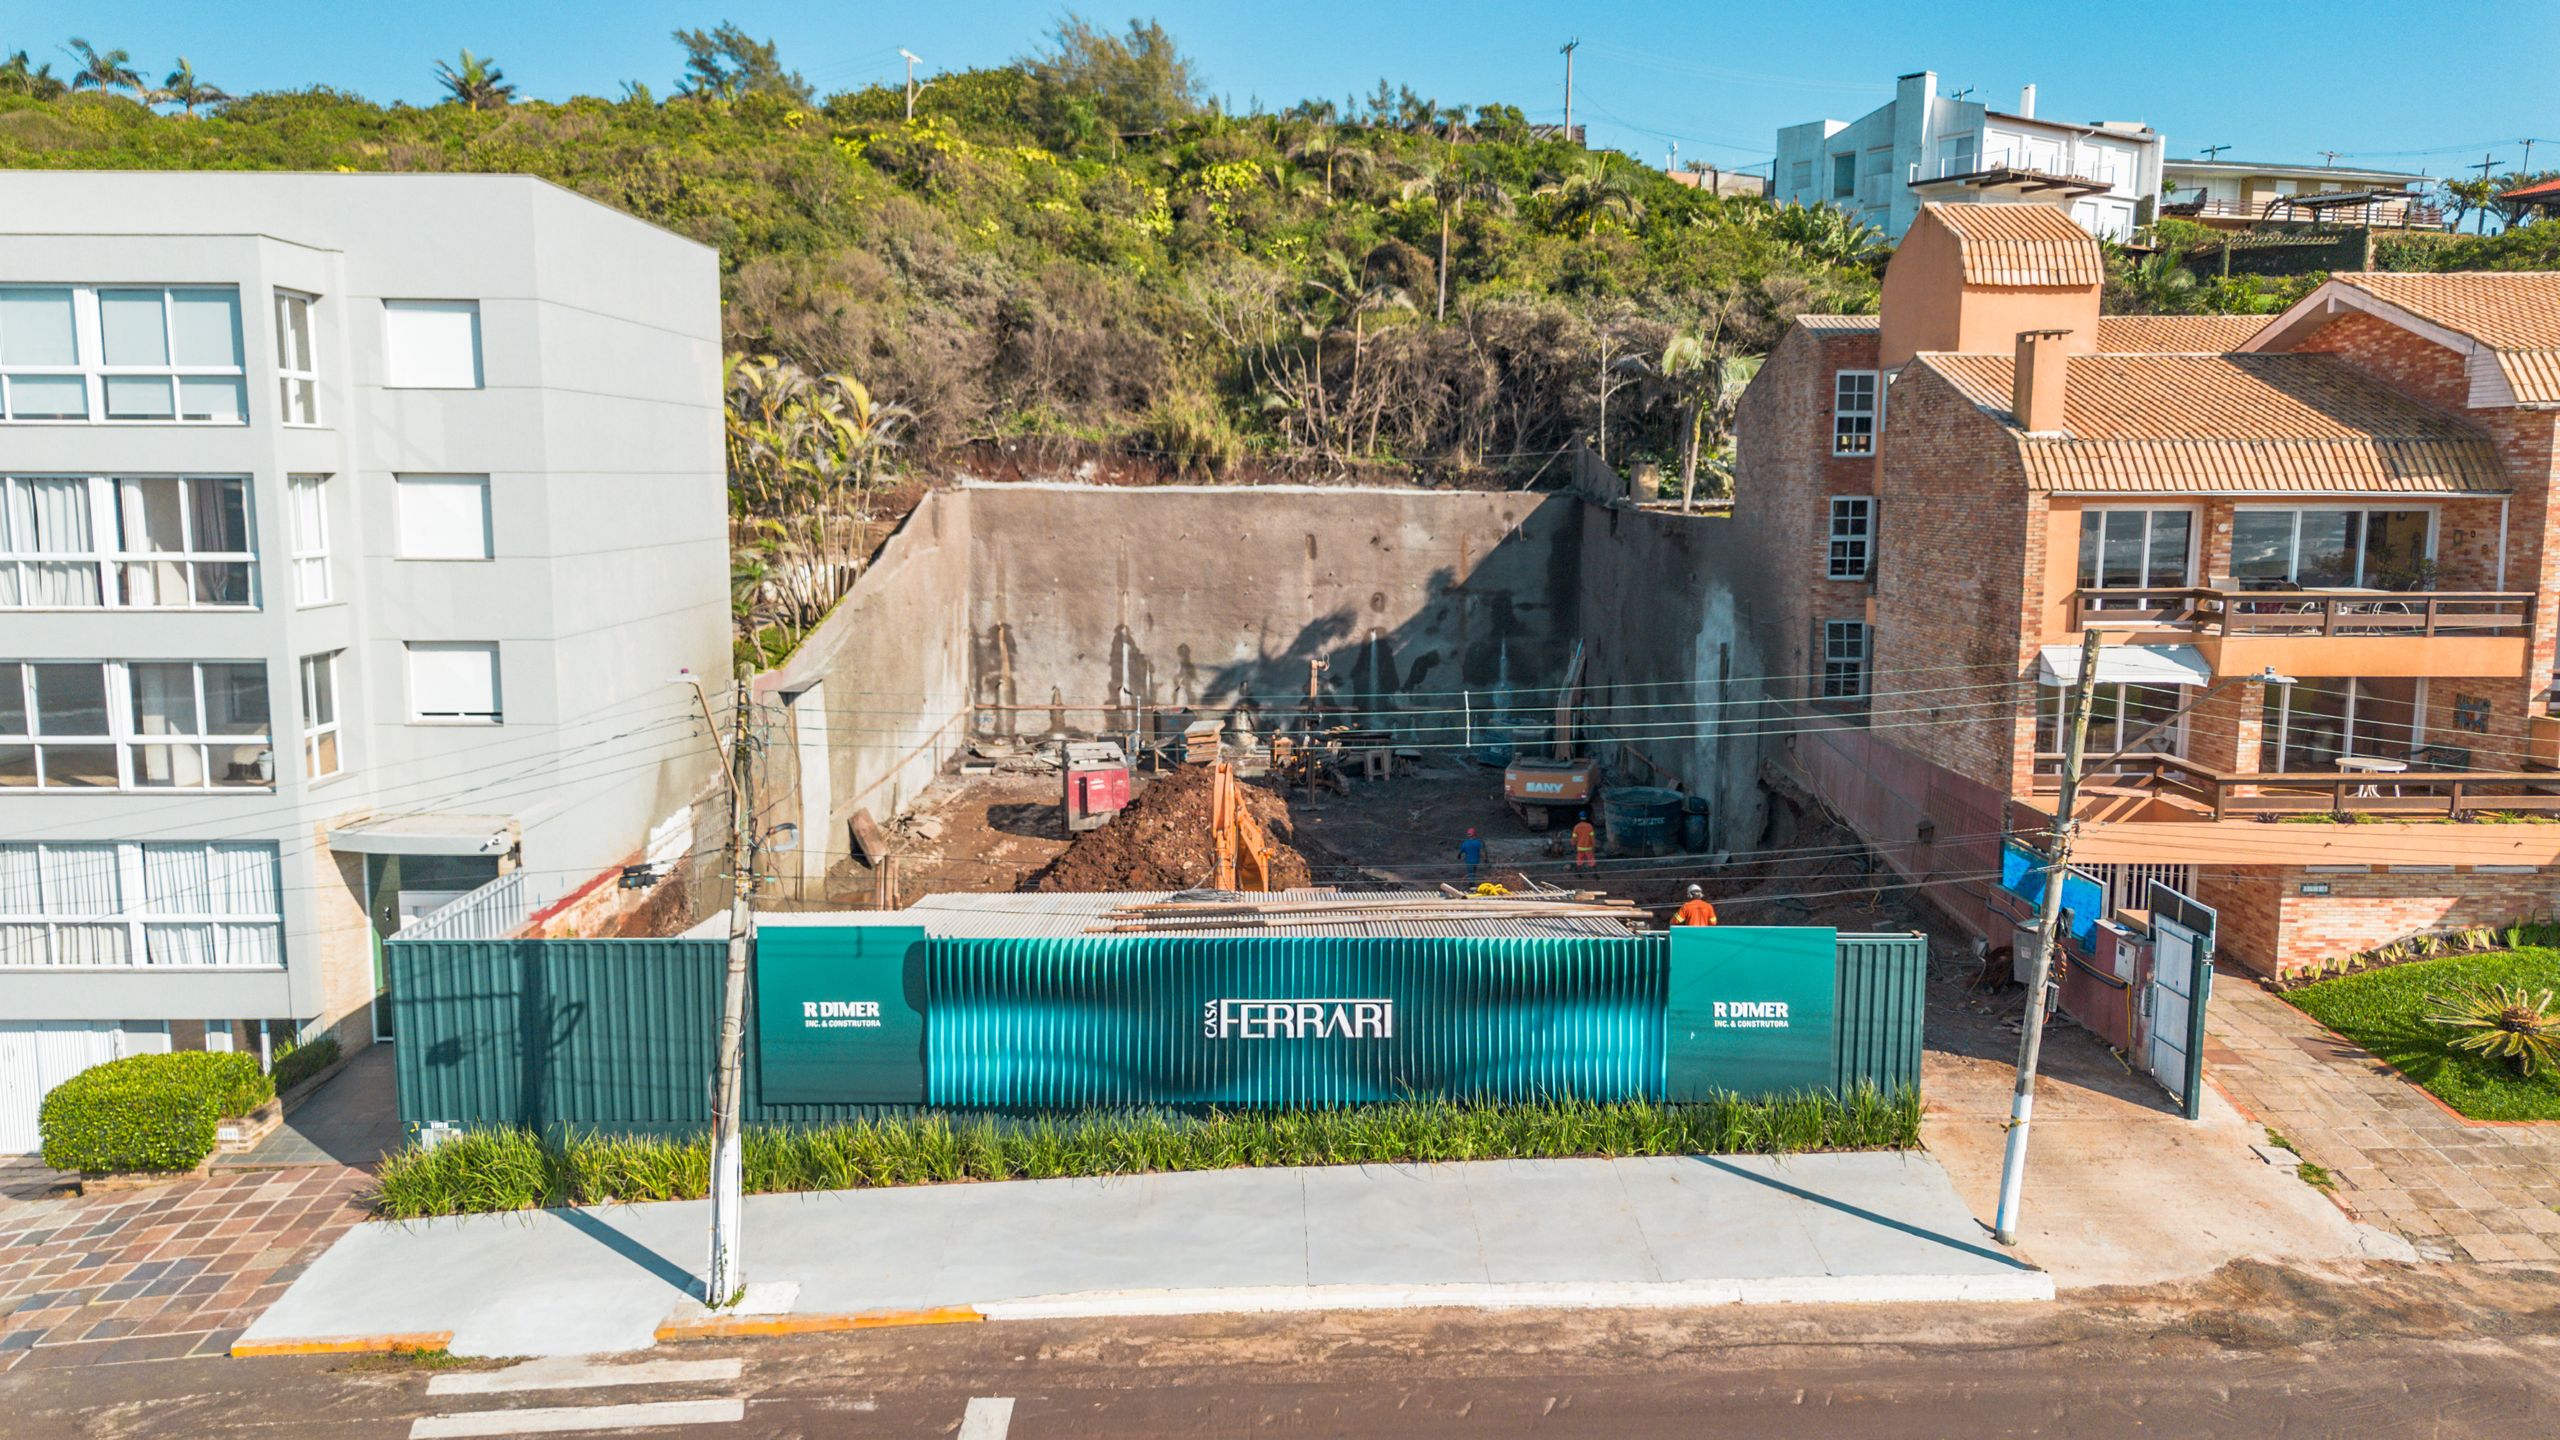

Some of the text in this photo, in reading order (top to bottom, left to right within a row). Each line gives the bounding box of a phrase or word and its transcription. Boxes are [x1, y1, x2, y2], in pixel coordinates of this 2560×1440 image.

[1526, 782, 1563, 793] SANY
[803, 1002, 880, 1017] R DIMER
[1713, 1002, 1789, 1017] R DIMER
[1205, 1000, 1217, 1038] CASA
[1220, 999, 1393, 1039] FERRARI
[1714, 1020, 1789, 1028] INC. & CONSTRUTORA
